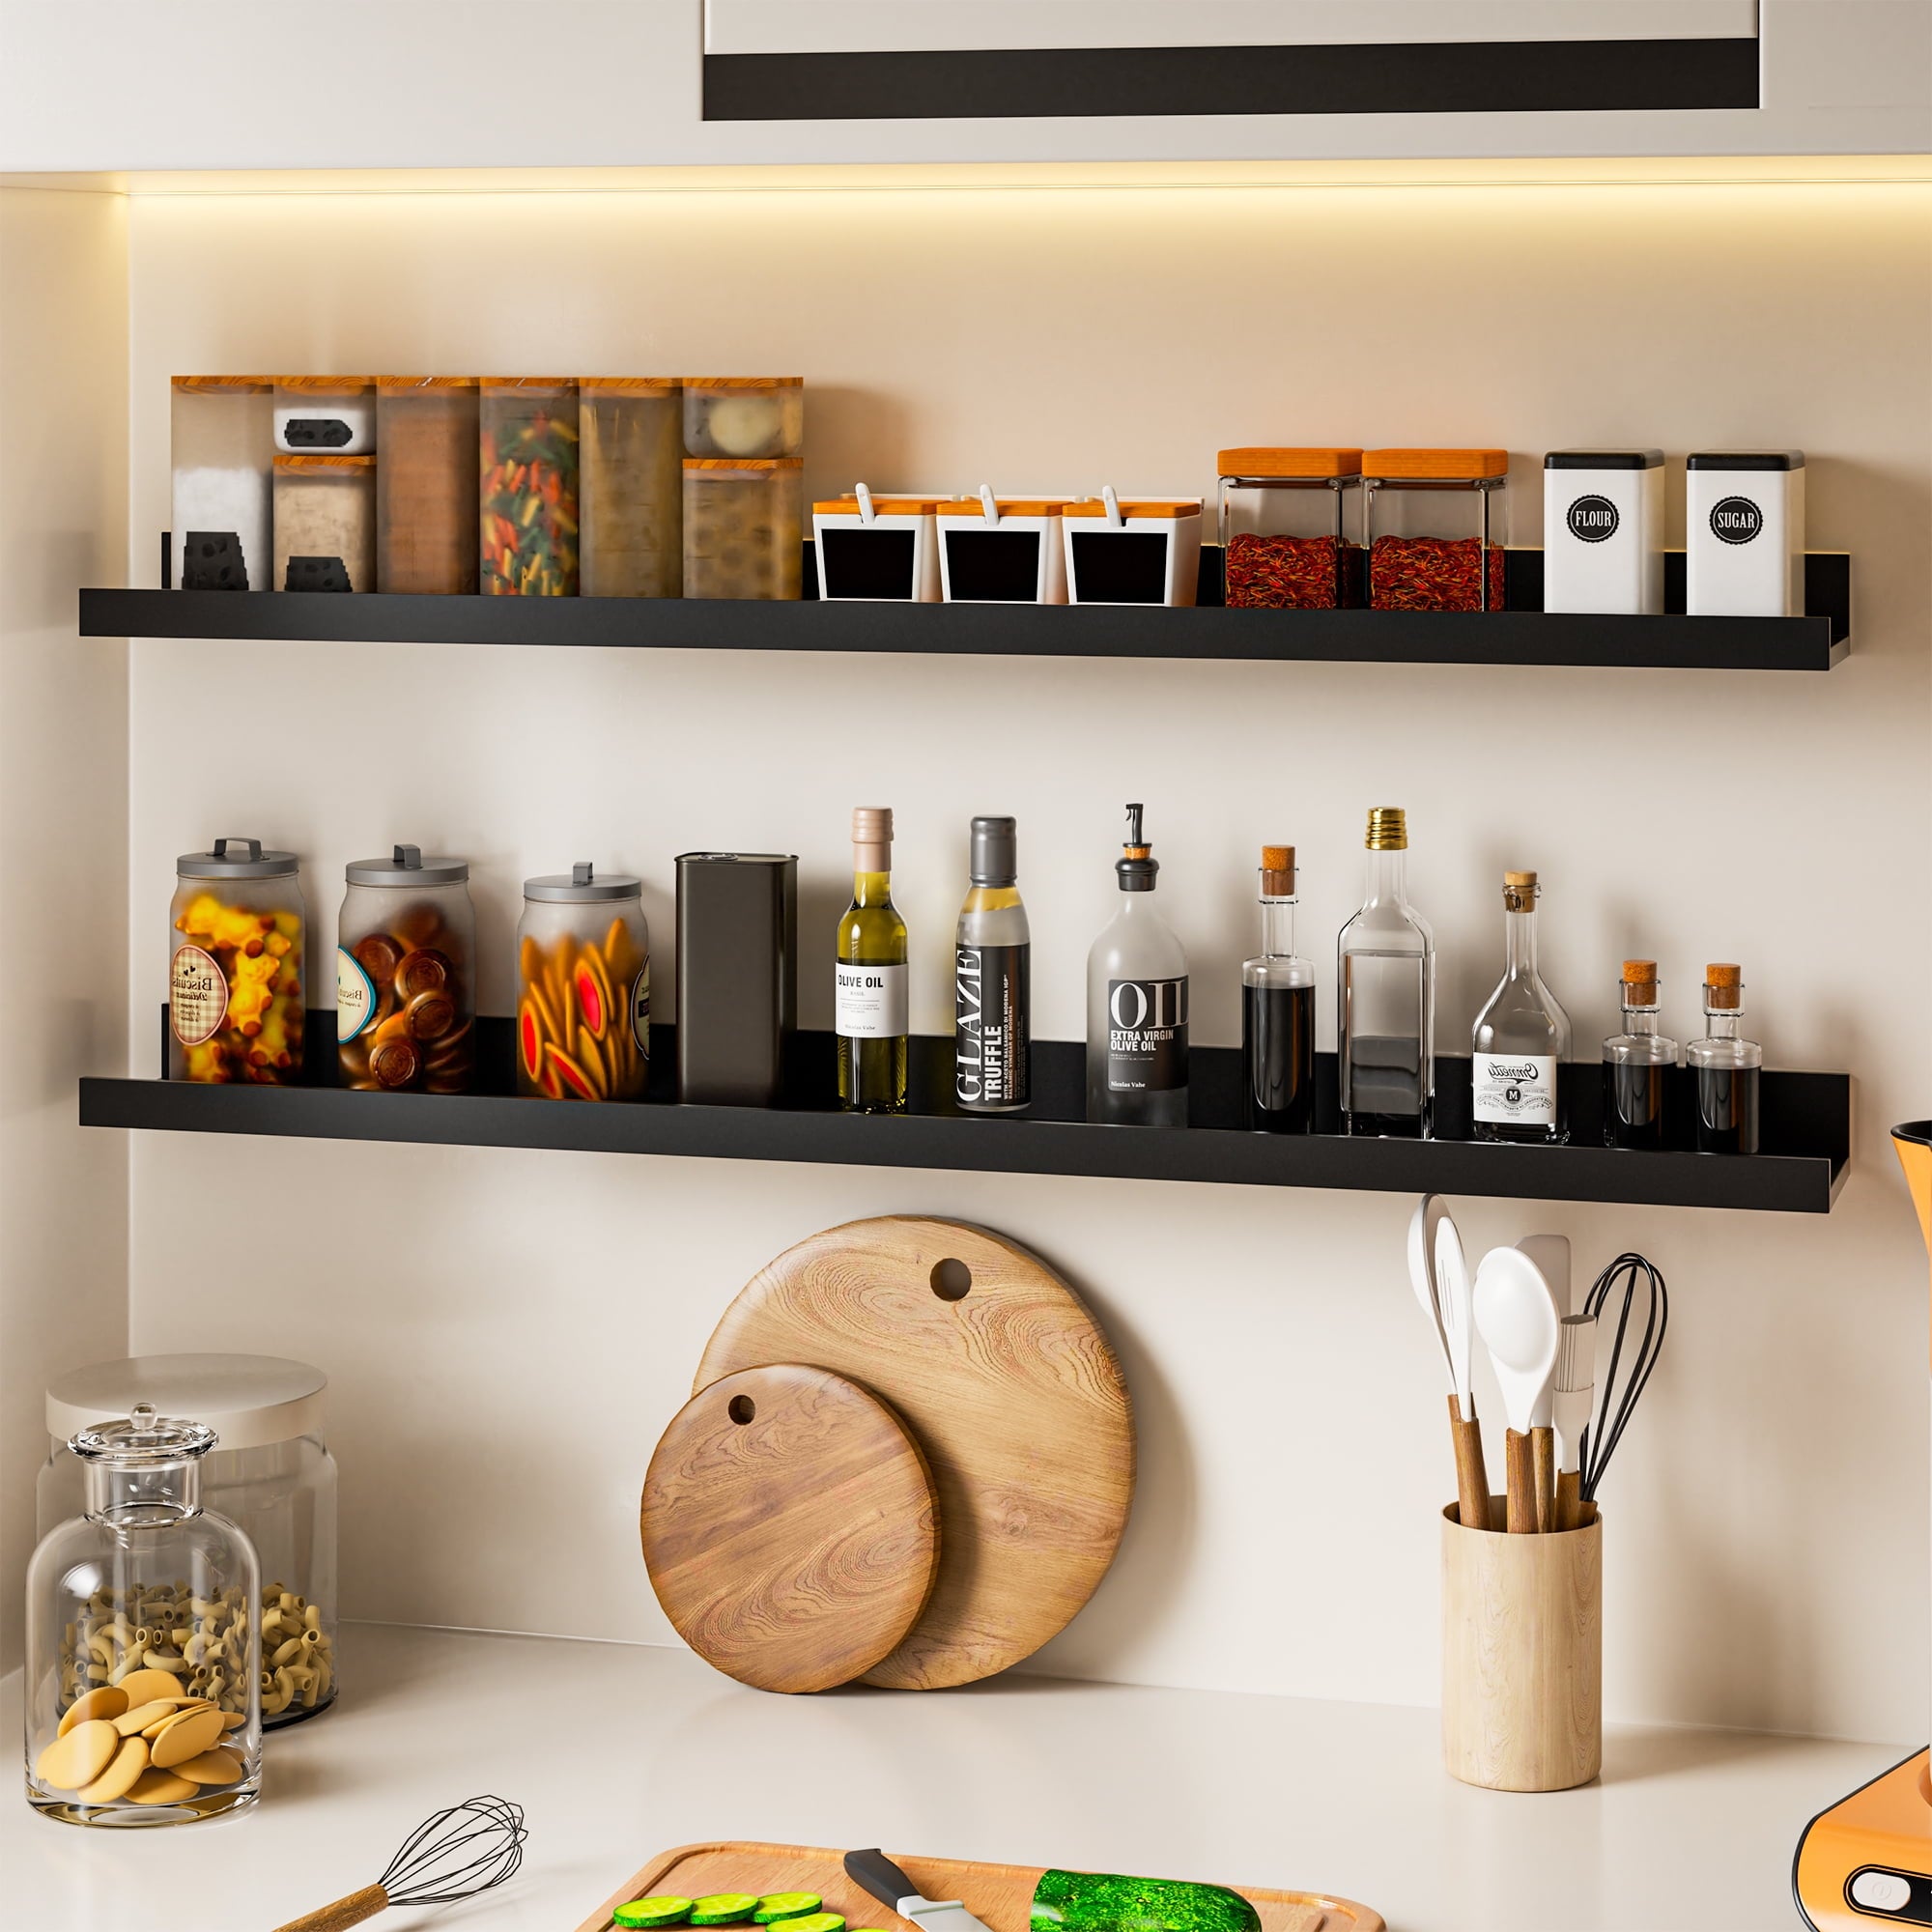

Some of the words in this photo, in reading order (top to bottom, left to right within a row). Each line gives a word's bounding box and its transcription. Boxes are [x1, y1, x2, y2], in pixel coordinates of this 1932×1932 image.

[1575, 510, 1612, 527] FLOUR
[1717, 512, 1755, 529] SUGAR
[838, 974, 862, 987] OLIVE
[866, 977, 884, 988] OIL
[1110, 980, 1189, 1029] OIL
[956, 949, 982, 1102] GLAZE
[1110, 1030, 1141, 1040] EXTRA
[1144, 1029, 1174, 1040] VIRGIN
[1110, 1040, 1138, 1051] OLIVE
[1141, 1040, 1157, 1051] OIL
[984, 1026, 1003, 1101] TRUFFLE
